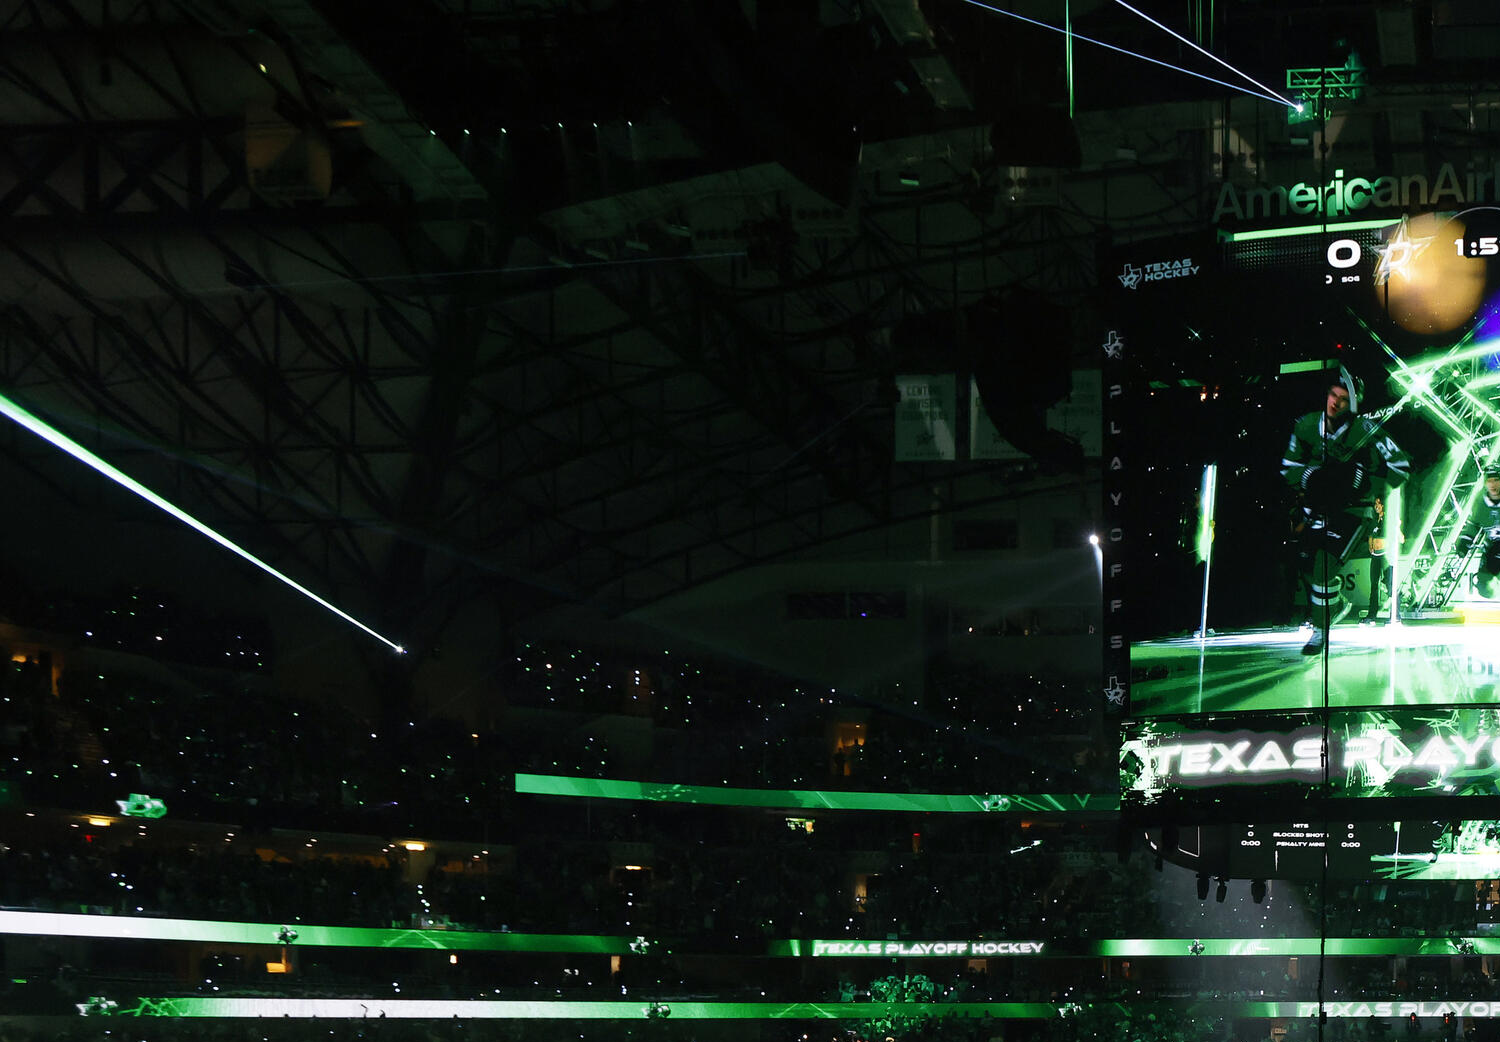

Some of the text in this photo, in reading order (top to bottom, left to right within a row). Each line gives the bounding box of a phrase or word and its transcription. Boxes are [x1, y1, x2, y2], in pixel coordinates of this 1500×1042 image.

[1327, 238, 1362, 269] 0
[1144, 266, 1200, 282] HOCKEY
[1145, 258, 1192, 273] TEXAS
[1109, 384, 1124, 650] PLAYOFFS
[1153, 736, 1321, 776] TEXAS
[815, 941, 1045, 956] TEXAS PLAYOFF HOCKEY
